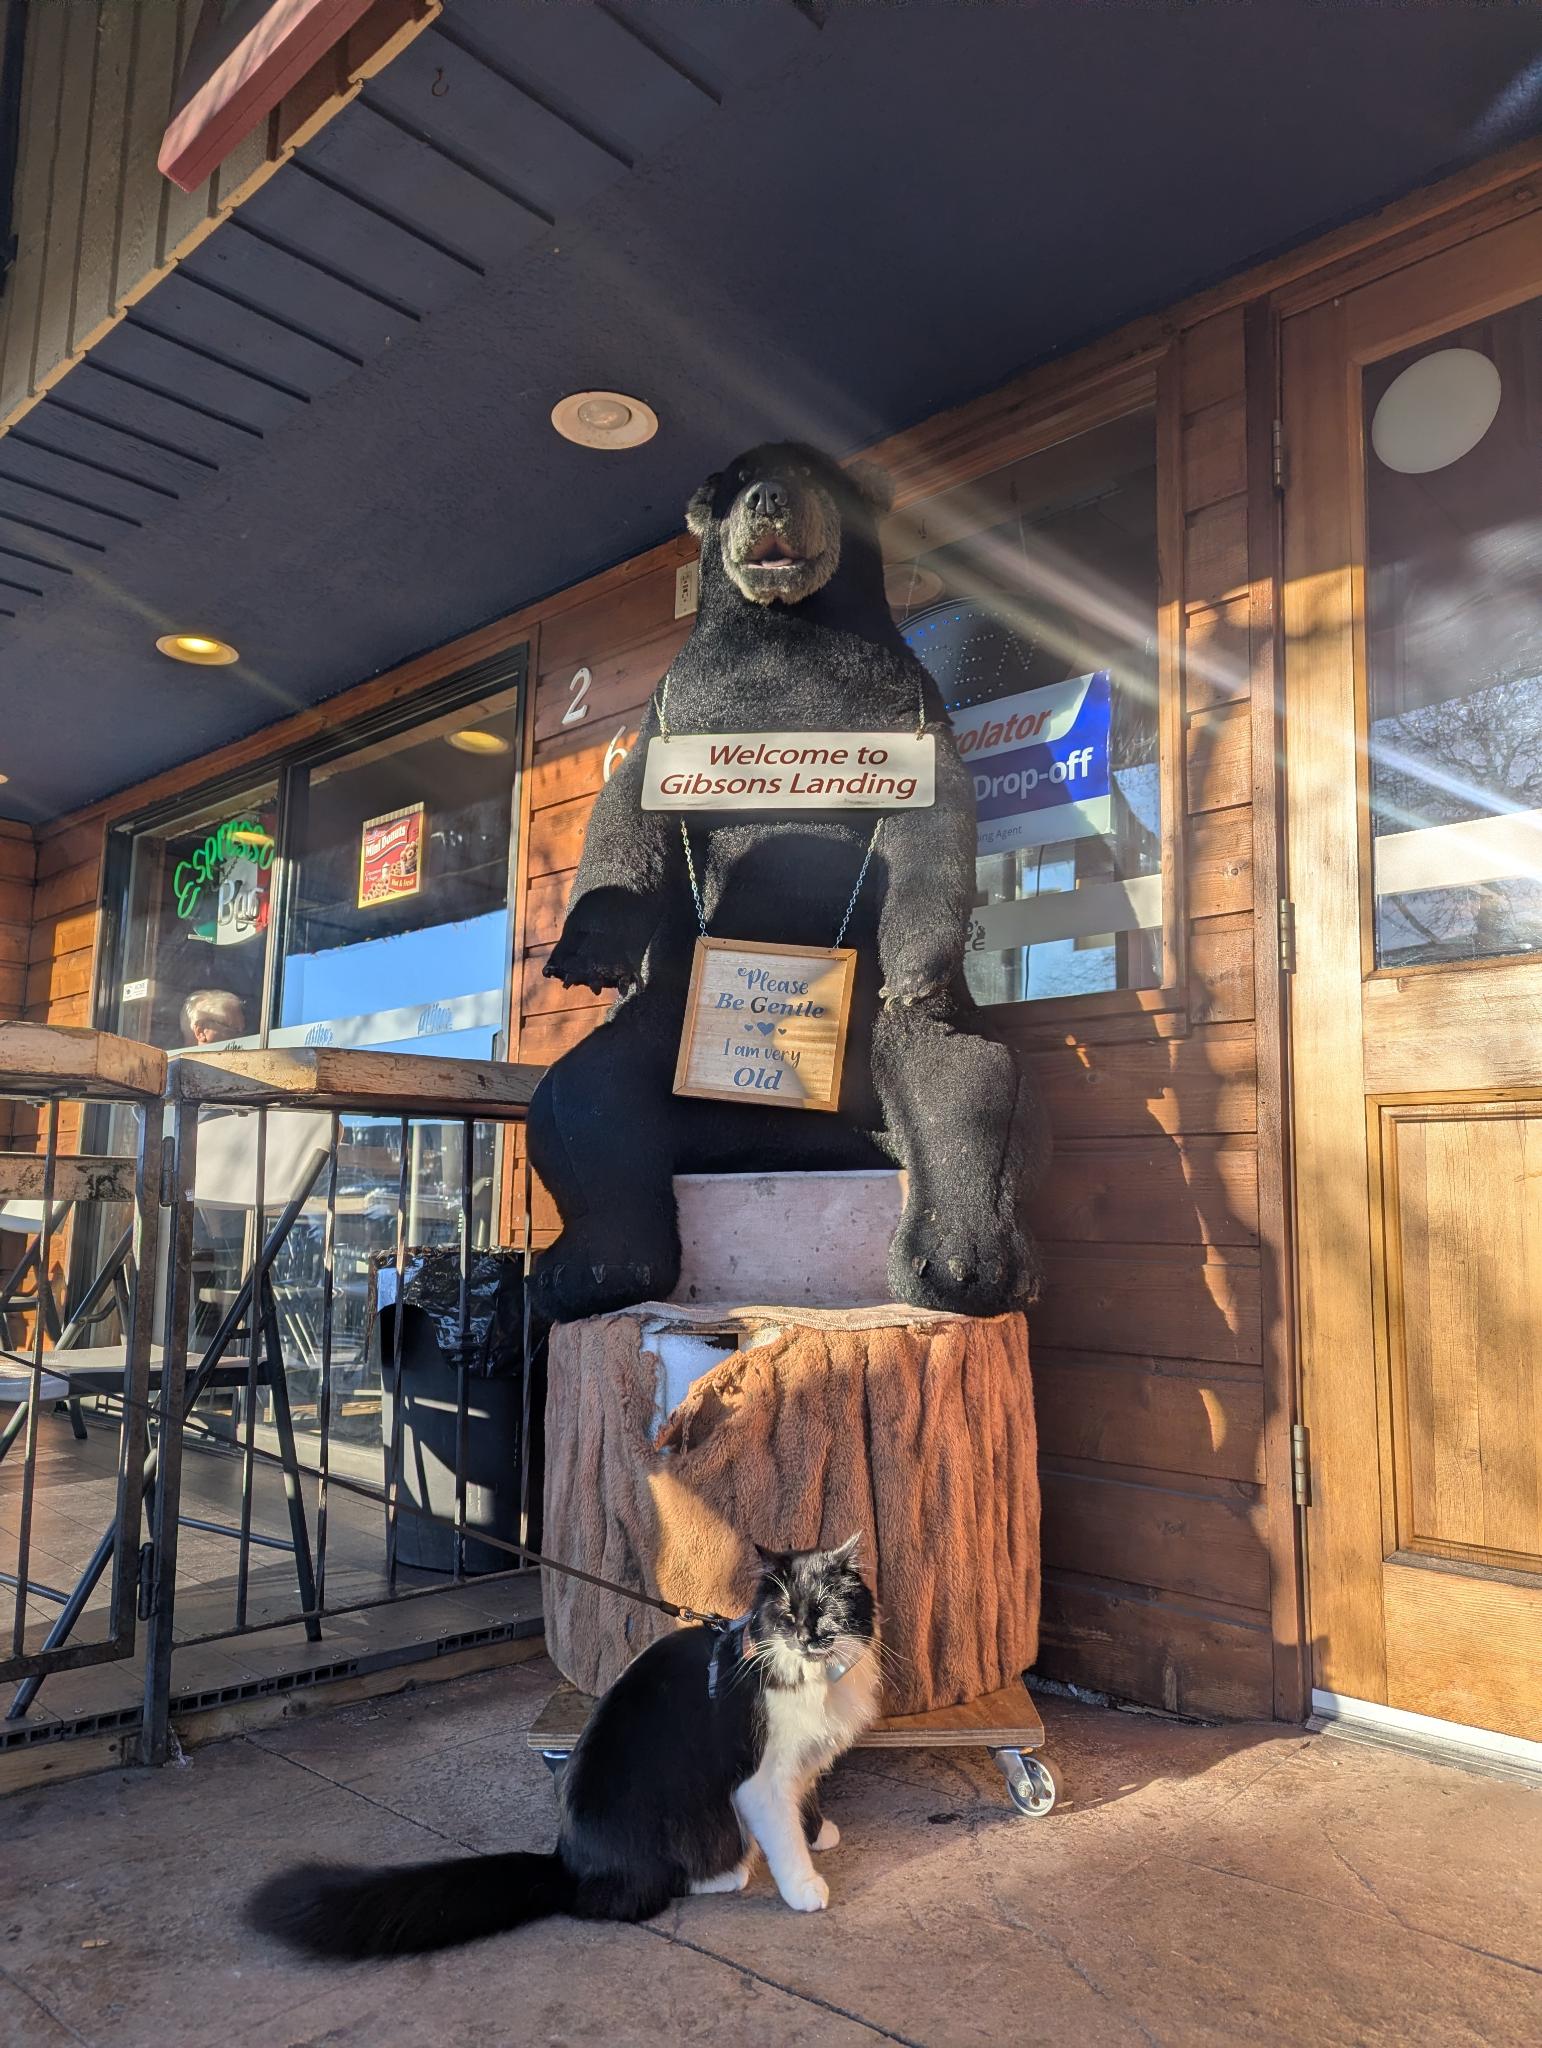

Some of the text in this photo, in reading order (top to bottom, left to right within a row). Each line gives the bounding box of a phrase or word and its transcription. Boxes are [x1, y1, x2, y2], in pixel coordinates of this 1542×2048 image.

[561, 667, 592, 725] 2
[710, 743, 888, 765] Welcome to
[659, 772, 918, 800] Gibsons Landing
[974, 746, 1094, 802] Drop-off
[996, 825, 1022, 841] Agent
[737, 967, 809, 995] Please
[715, 992, 826, 1019] Be Gentle
[723, 1038, 801, 1069] I am very
[733, 1067, 784, 1091] Old
